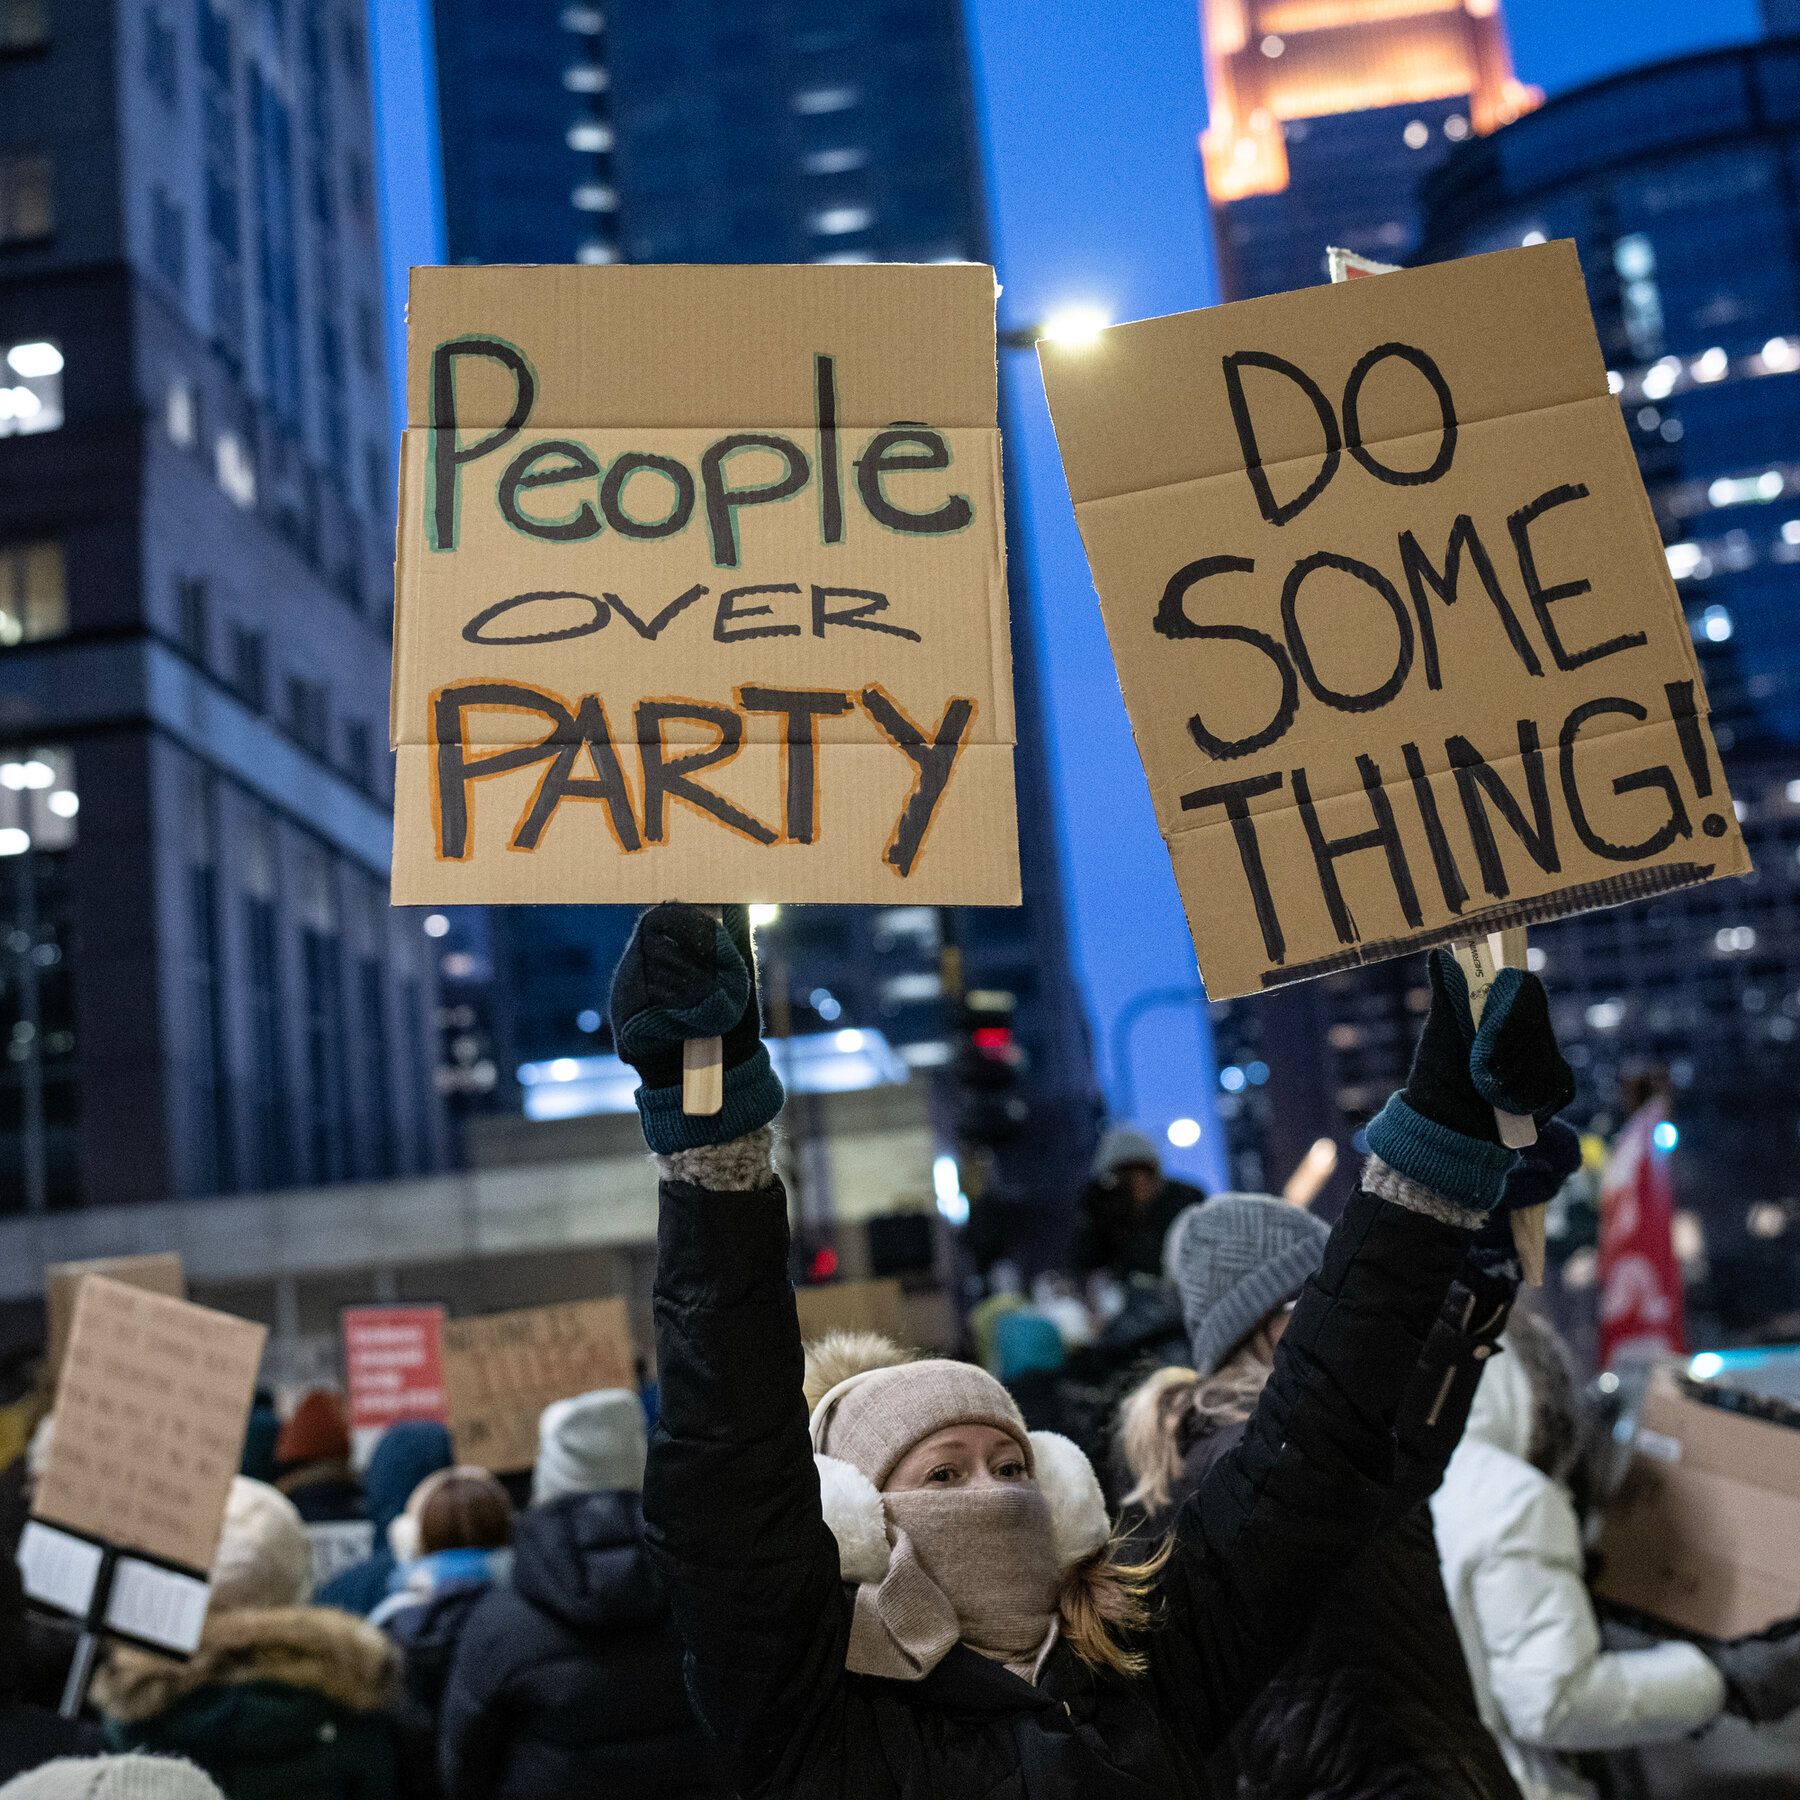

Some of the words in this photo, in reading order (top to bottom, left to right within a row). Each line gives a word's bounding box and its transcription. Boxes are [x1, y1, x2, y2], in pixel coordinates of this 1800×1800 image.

[427, 334, 976, 568] People
[1221, 342, 1460, 527] DO
[462, 582, 922, 645] OVER
[1152, 483, 1648, 760] SOME
[429, 678, 977, 877] PARTY
[1180, 679, 1728, 965] THING!
[1468, 940, 1484, 978] SHERWIN
